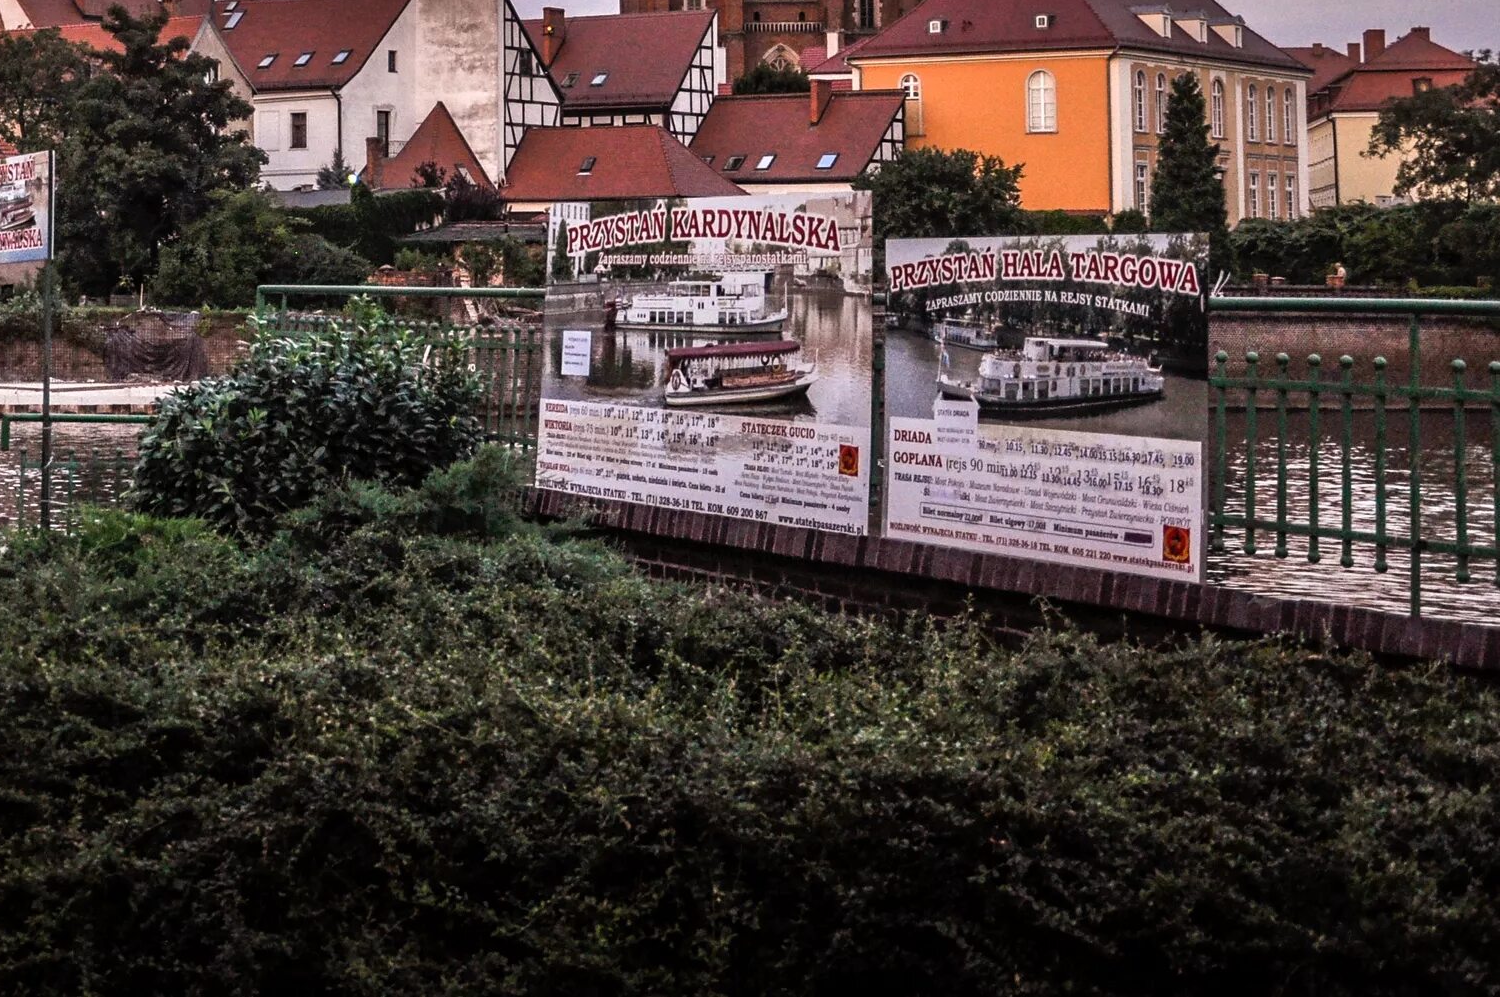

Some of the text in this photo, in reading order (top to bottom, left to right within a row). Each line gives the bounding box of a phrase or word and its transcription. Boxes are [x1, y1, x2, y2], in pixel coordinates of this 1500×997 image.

[568, 204, 841, 253] PRZYSTAŃ KARDYNALSKA
[598, 252, 646, 268] Zapraszamy
[650, 251, 697, 265] codziennie
[712, 252, 739, 268] rejsy
[740, 251, 806, 267] parostatkami
[890, 246, 1199, 294] PRZYSTAŃ HALA TARGOWA
[925, 290, 1150, 317] ZAPRASZAMY CODZIENNIE NA REJSY STATKAMI
[741, 422, 787, 436] STATECZEK
[789, 427, 815, 439] GUCIO
[894, 429, 931, 443] DRIADA
[894, 451, 942, 467] GOPLANA
[946, 456, 967, 473] (rejs
[970, 458, 983, 471] 90
[727, 506, 738, 515] 609
[741, 508, 753, 517] 200
[990, 515, 1002, 524] Bilet
